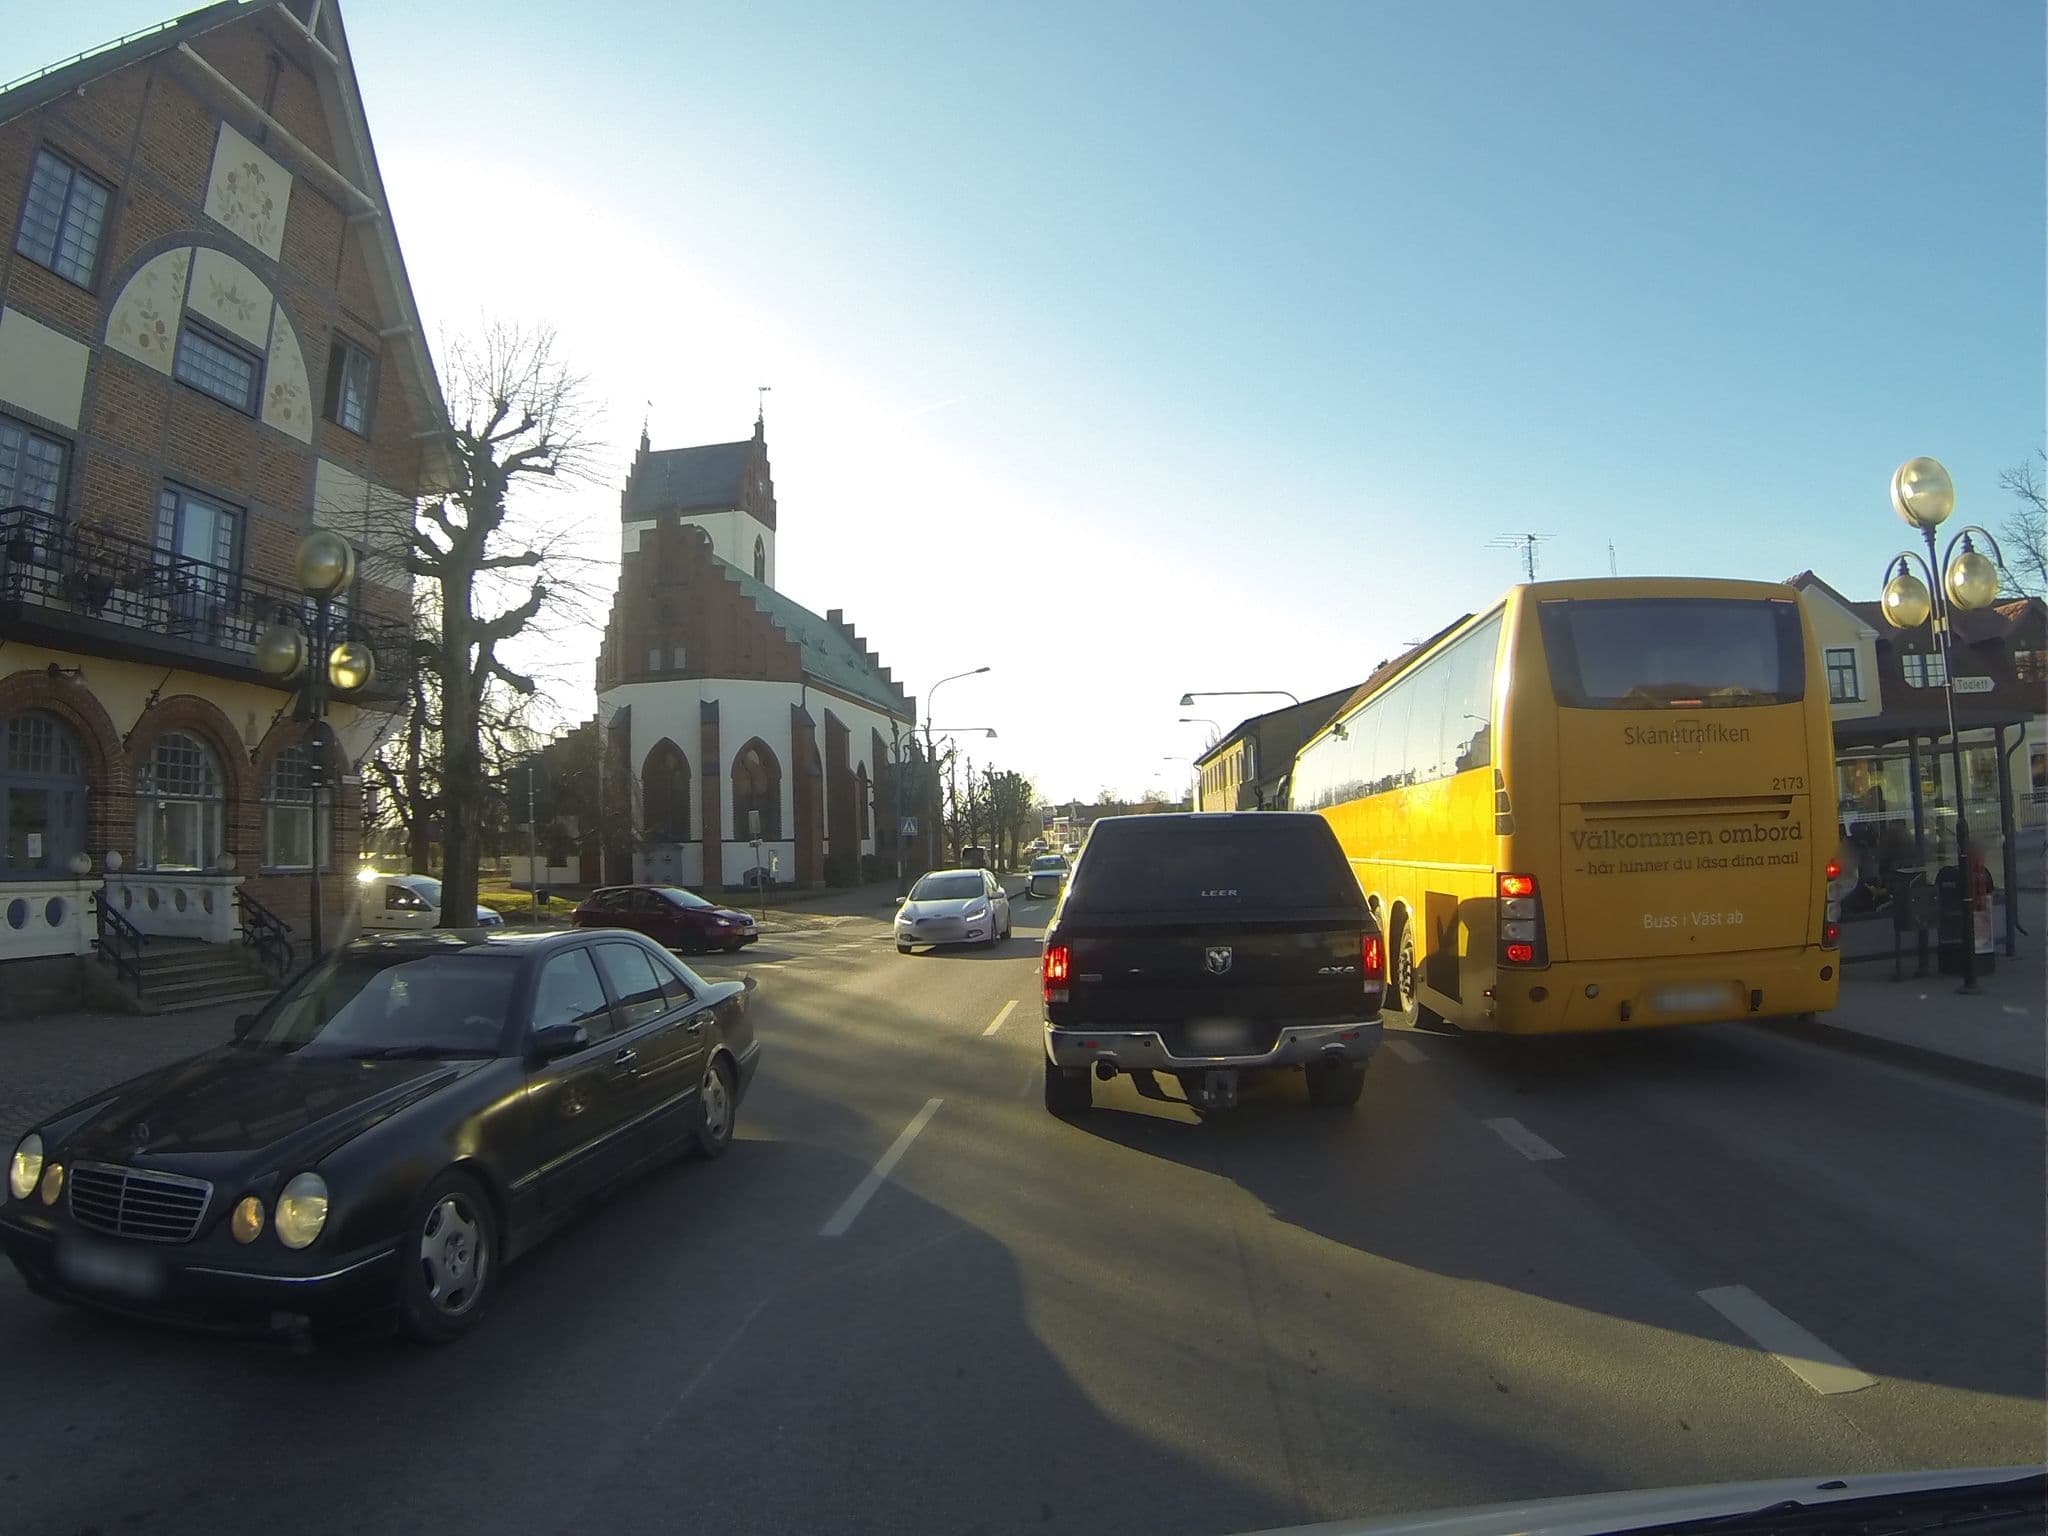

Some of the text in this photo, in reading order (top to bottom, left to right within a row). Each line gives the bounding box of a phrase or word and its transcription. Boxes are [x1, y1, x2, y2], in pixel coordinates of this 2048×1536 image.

[1772, 776, 1804, 791] 2173
[1569, 821, 1802, 851] Välkommen ombord
[1618, 858, 1669, 873] hinner
[1673, 857, 1692, 871] du
[1696, 855, 1728, 870] läsa
[1731, 853, 1765, 868] dina
[1767, 851, 1799, 866] mail
[1201, 889, 1238, 897] LEER
[1643, 913, 1678, 929] Buss
[1727, 909, 1743, 924] ab
